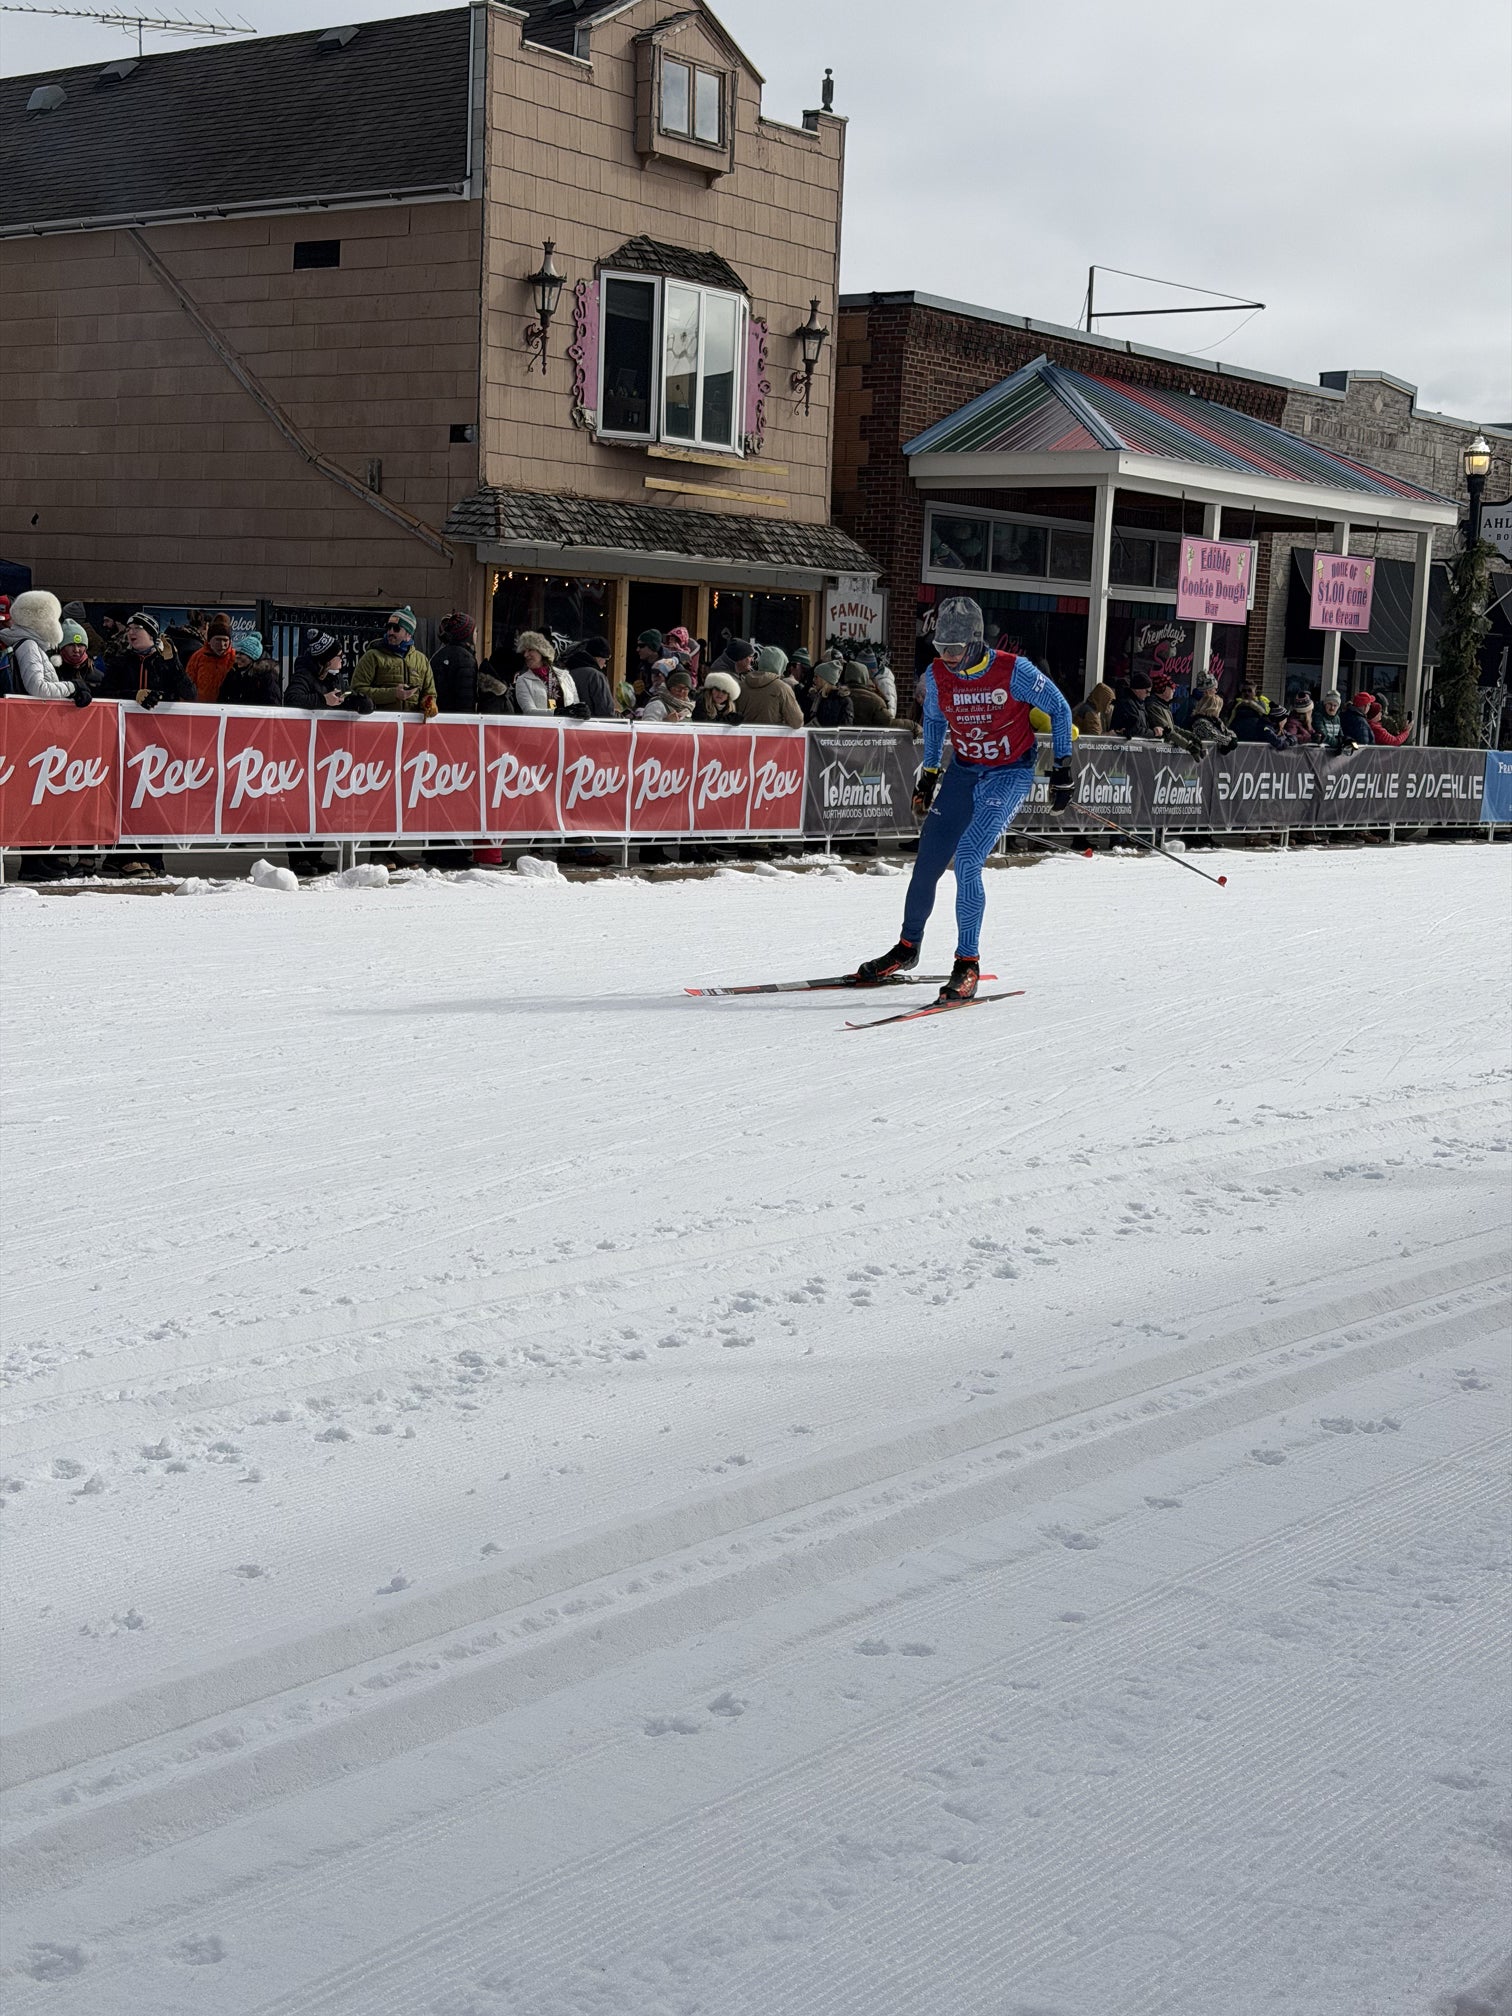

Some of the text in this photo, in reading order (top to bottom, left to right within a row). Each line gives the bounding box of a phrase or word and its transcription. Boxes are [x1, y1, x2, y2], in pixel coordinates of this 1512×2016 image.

[1201, 547, 1231, 575] Edible
[1182, 576, 1246, 604] Cookie Dough
[1318, 580, 1368, 607] $1.00 cone
[830, 602, 878, 624] FAMILY
[1204, 600, 1219, 616] Bar
[1321, 606, 1360, 627] Ice Cream
[839, 621, 867, 638] FUN
[1137, 623, 1187, 647] Tremblay's
[1149, 641, 1195, 677] Sweet
[953, 692, 992, 706] BIRKIE
[956, 714, 992, 722] PIONEER
[872, 738, 882, 746] THE
[956, 735, 1011, 760] 2351
[28, 744, 110, 806] Rex
[127, 744, 215, 809] Rex
[226, 746, 305, 809] Rex
[316, 748, 392, 809] Rex
[403, 750, 476, 809] Rex
[487, 752, 553, 809] Rex
[565, 755, 626, 810] Rex
[634, 757, 690, 810] Rex
[698, 758, 748, 810] Rex
[754, 760, 802, 810] Rex
[820, 760, 893, 808] Telemark
[1077, 762, 1133, 804] Telemark
[1153, 765, 1203, 805] Telemark
[823, 807, 893, 819] NORTHWOODS LODGING
[1112, 806, 1132, 815] LODGING
[1183, 806, 1202, 815] LODGING
